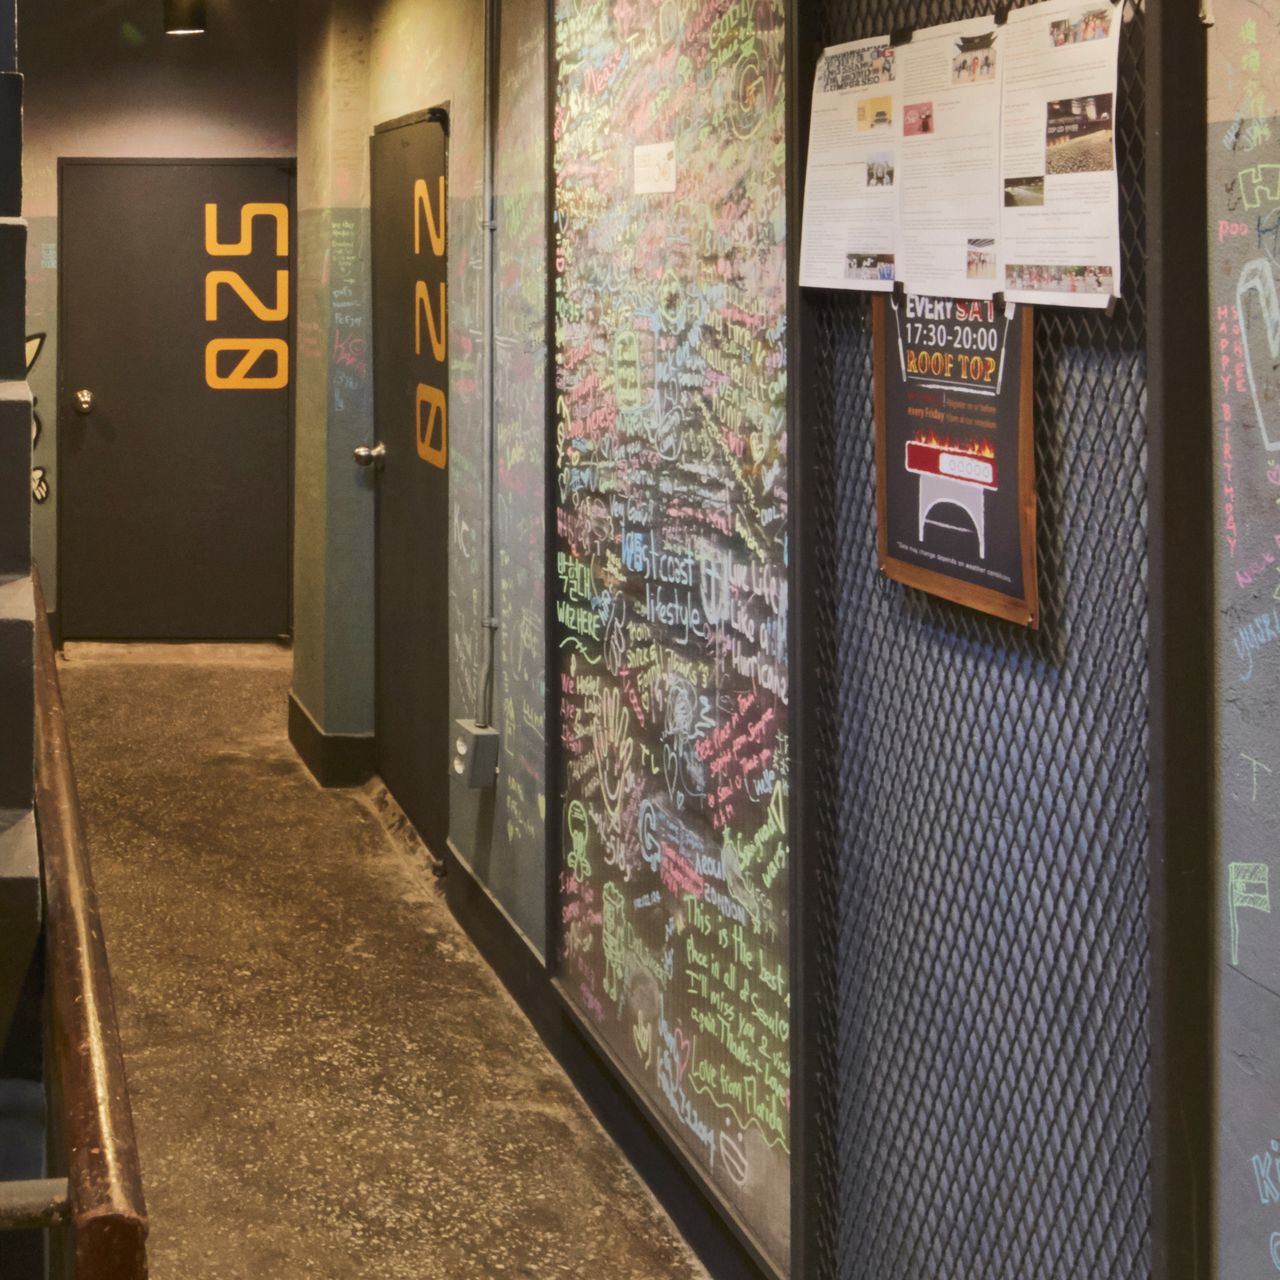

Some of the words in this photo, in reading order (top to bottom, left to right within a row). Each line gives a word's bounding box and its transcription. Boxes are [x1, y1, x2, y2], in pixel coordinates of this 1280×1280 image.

[205, 202, 289, 389] 025
[906, 294, 953, 320] EVERY
[906, 323, 998, 352] 17:30-20:00
[1217, 304, 1231, 395] HAPPY
[907, 349, 954, 377] ROOF
[958, 354, 996, 382] TOP
